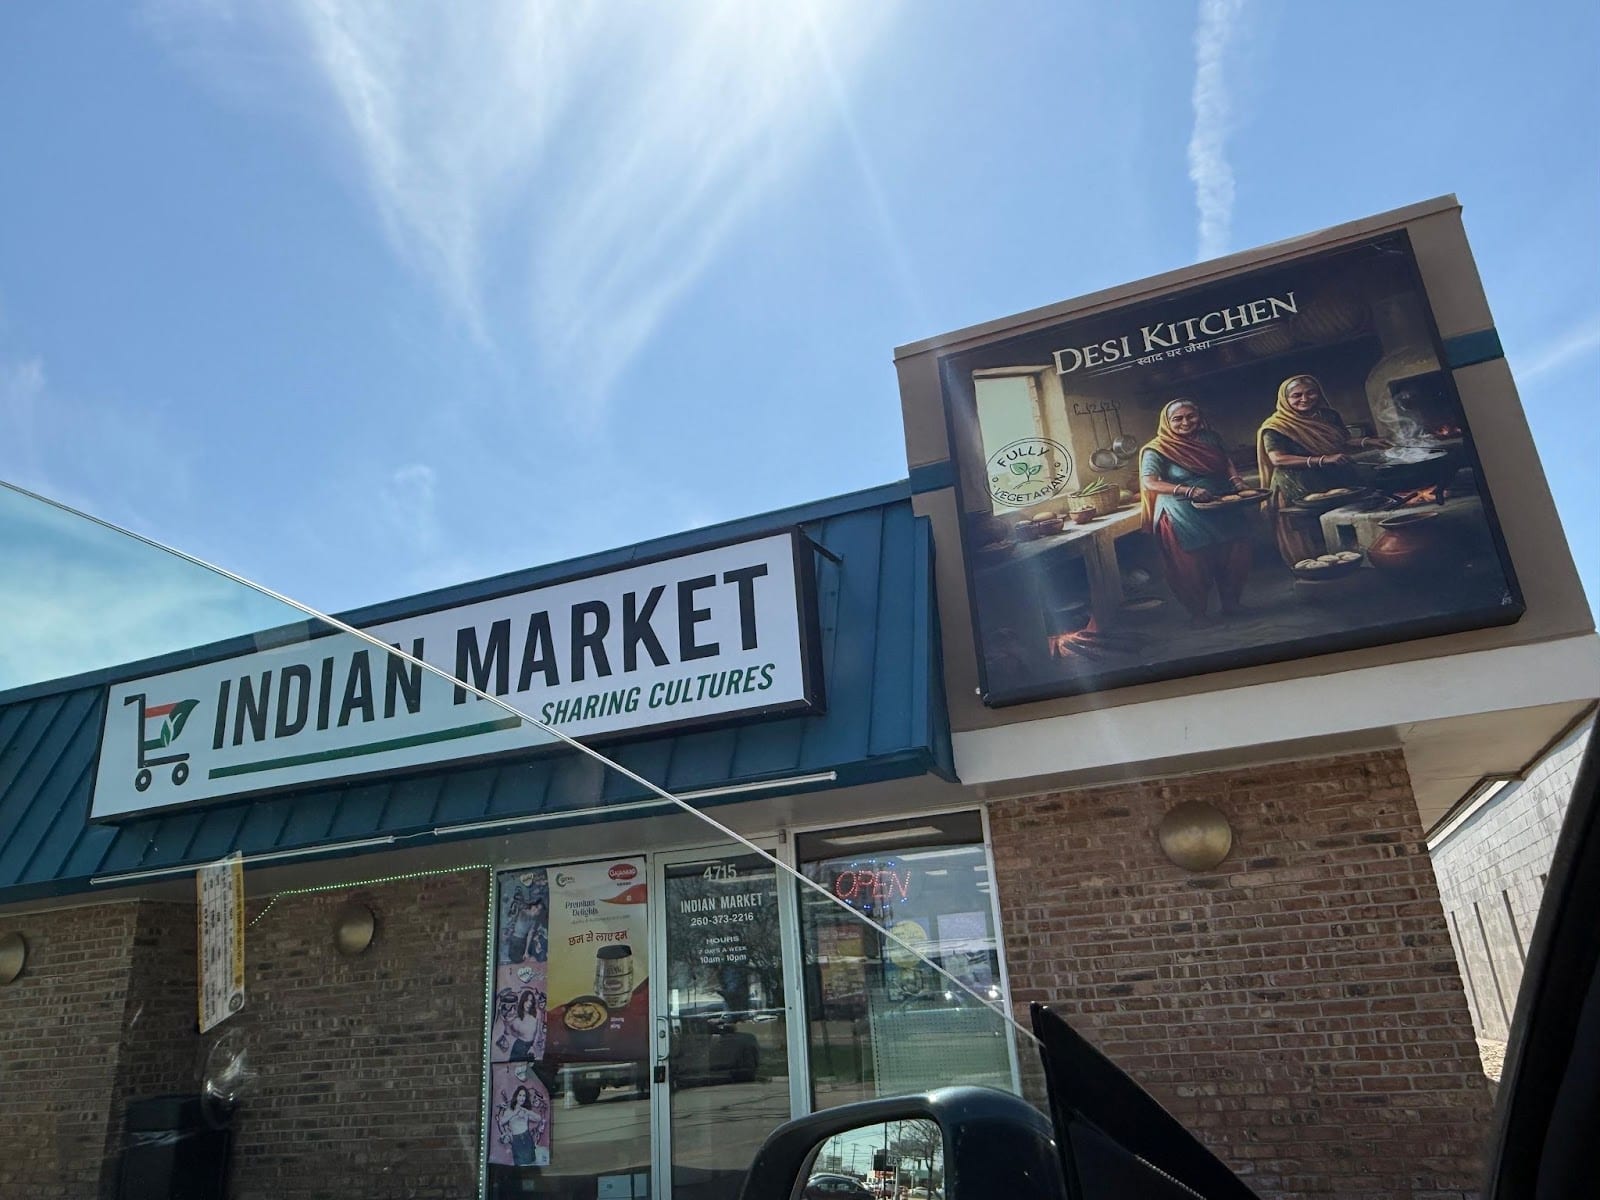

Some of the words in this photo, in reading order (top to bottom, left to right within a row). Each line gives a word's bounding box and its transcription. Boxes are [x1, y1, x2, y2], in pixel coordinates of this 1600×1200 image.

[1052, 336, 1132, 376] DESI
[1140, 292, 1298, 352] KITCHEN
[997, 446, 1050, 468] FULLY
[994, 473, 1066, 502] VEGETARIAN
[212, 637, 425, 750] INDIAN
[453, 563, 768, 705] MARKET
[539, 686, 641, 726] SHARING
[648, 663, 775, 709] CULTURES
[703, 864, 737, 881] 4715
[835, 870, 912, 898] OPEN
[680, 897, 715, 913] INDIAN
[720, 892, 762, 909] MARKET
[690, 912, 754, 926] 260-373-2216
[706, 936, 740, 944] HOURS
